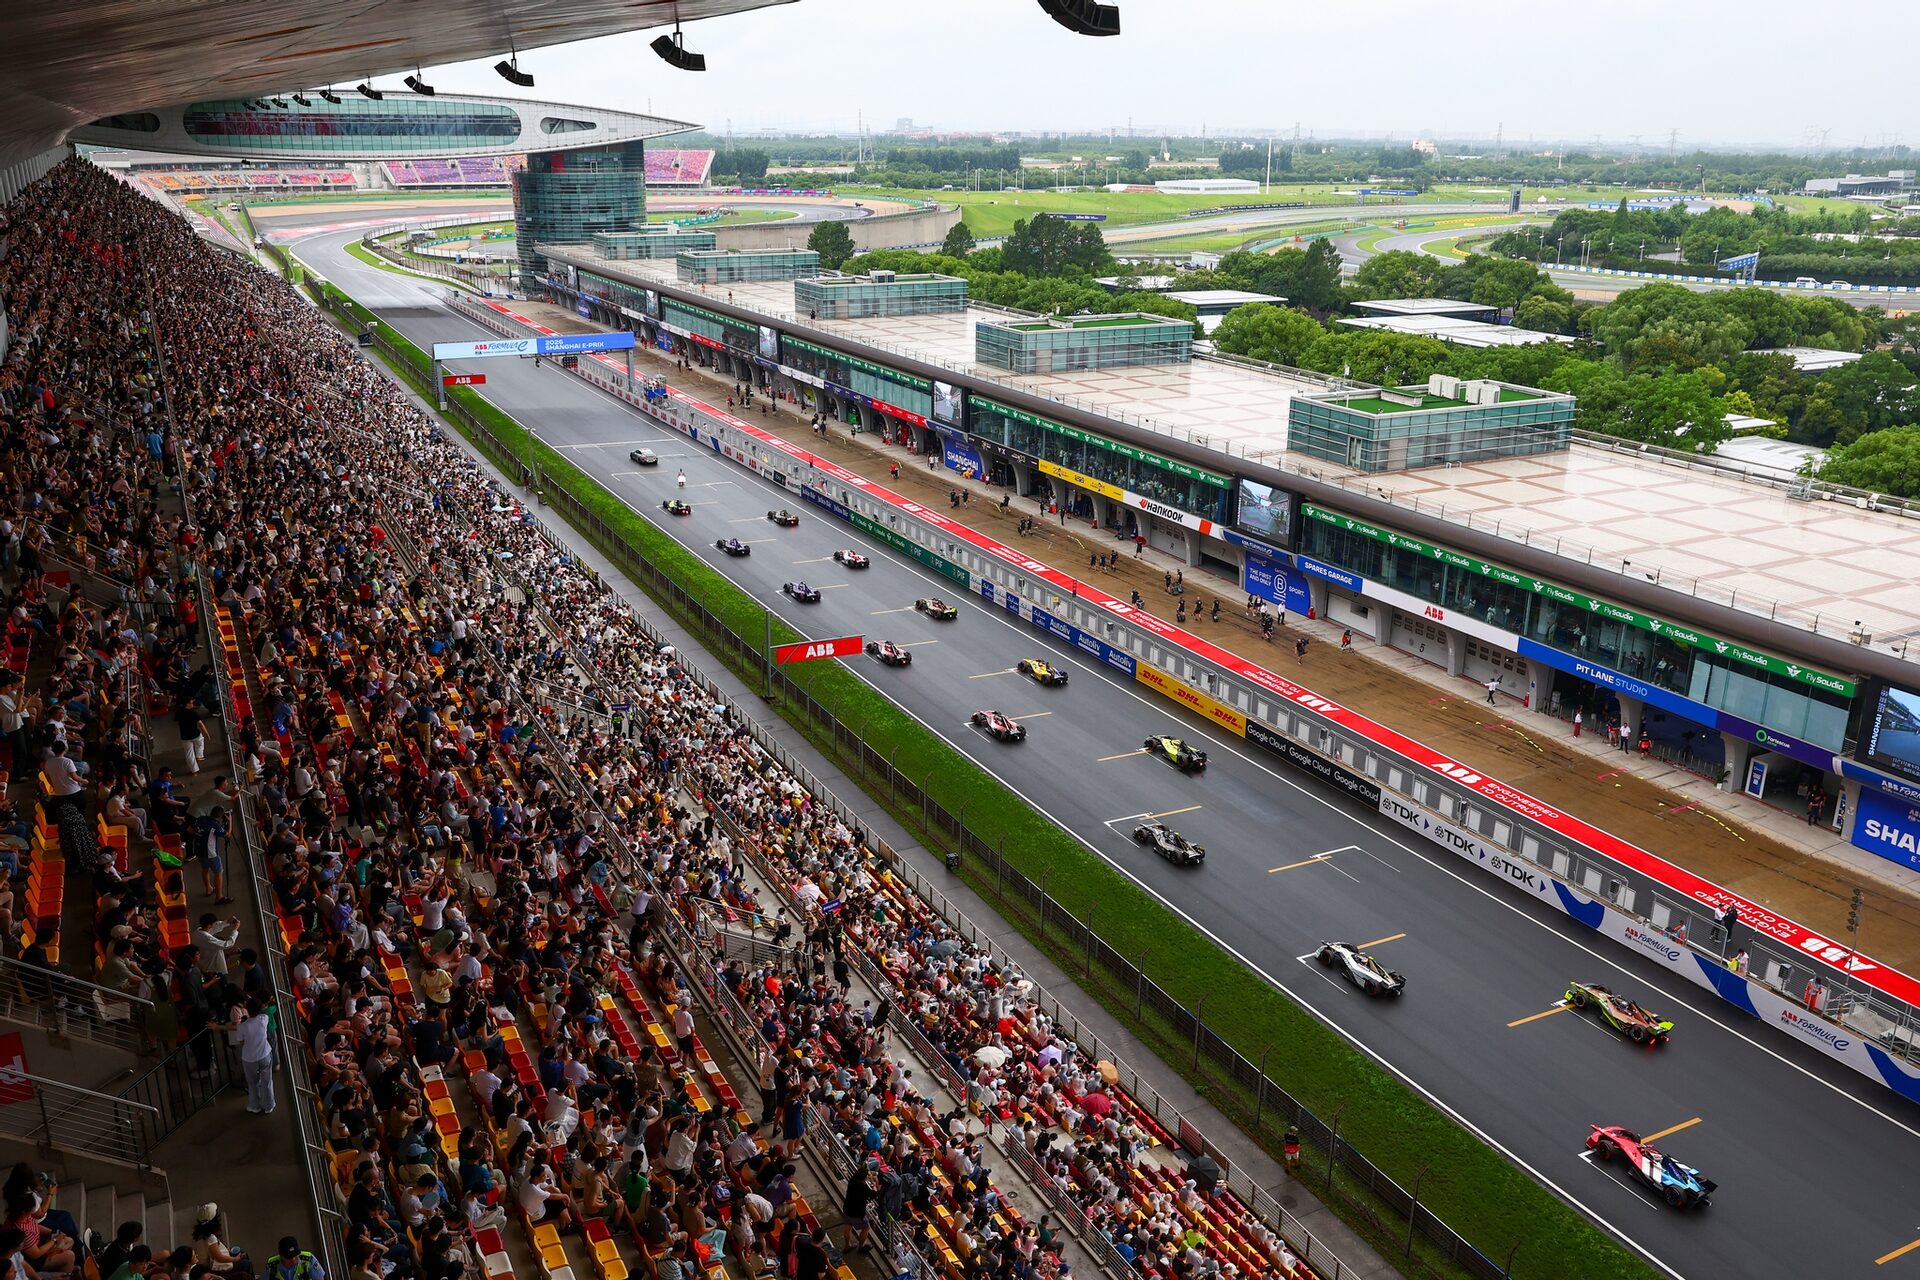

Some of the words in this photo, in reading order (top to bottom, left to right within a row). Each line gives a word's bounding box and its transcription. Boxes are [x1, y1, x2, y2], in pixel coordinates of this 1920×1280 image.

[1446, 554, 1470, 567] FlySaudia
[1250, 568, 1259, 576] THE
[1259, 571, 1272, 580] FIRST
[1250, 574, 1260, 582] AND
[1260, 578, 1272, 586] ONLY
[1304, 561, 1328, 576] SPARES
[1328, 570, 1353, 585] GARAGE
[1494, 570, 1520, 584] FlySaudia
[1547, 587, 1575, 602] FlySaudia
[1424, 606, 1444, 621] ABB
[1604, 607, 1634, 622] FlySaudia
[1050, 619, 1071, 635] Autoliv
[1666, 627, 1698, 643] FlySaudia
[806, 643, 835, 658] ABB
[1079, 634, 1100, 652] Autoliv
[1419, 644, 1426, 653] 5
[1109, 650, 1133, 668] Autoliv
[1733, 649, 1768, 666] FlySaudia
[1142, 670, 1165, 688] DHL
[1576, 664, 1591, 674] PIT
[1590, 669, 1615, 684] LANE
[1615, 678, 1648, 697] STUDIO
[1806, 673, 1844, 691] FlySaudia
[1177, 688, 1200, 707] DHL
[1214, 708, 1238, 727] DHL
[1247, 724, 1269, 743] Google
[1269, 737, 1287, 752] Cloud
[1768, 736, 1791, 749] Fortescue
[1868, 714, 1882, 757] SHANGHAI
[1289, 747, 1312, 765] Google
[1312, 760, 1331, 776] Cloud
[1431, 762, 1483, 784] ABB
[1334, 771, 1358, 790] Google
[1359, 785, 1380, 802] Cloud
[1881, 780, 1899, 792] ABB
[1479, 786, 1495, 795] TO
[1496, 794, 1543, 818] OUTRUN
[1487, 783, 1560, 819] ENGINEERED
[1392, 801, 1420, 826] TDK
[1444, 829, 1475, 857] TDK
[1865, 819, 1920, 855] SHA
[1501, 860, 1535, 889] TDK
[1714, 892, 1776, 922] OUTRUN
[1779, 922, 1798, 935] TO
[1625, 927, 1639, 938] ABB
[1638, 934, 1670, 954] FORMULA
[1800, 937, 1878, 971] ABB
[1782, 1010, 1798, 1023] ABB
[1798, 1019, 1837, 1042] FORMULA
